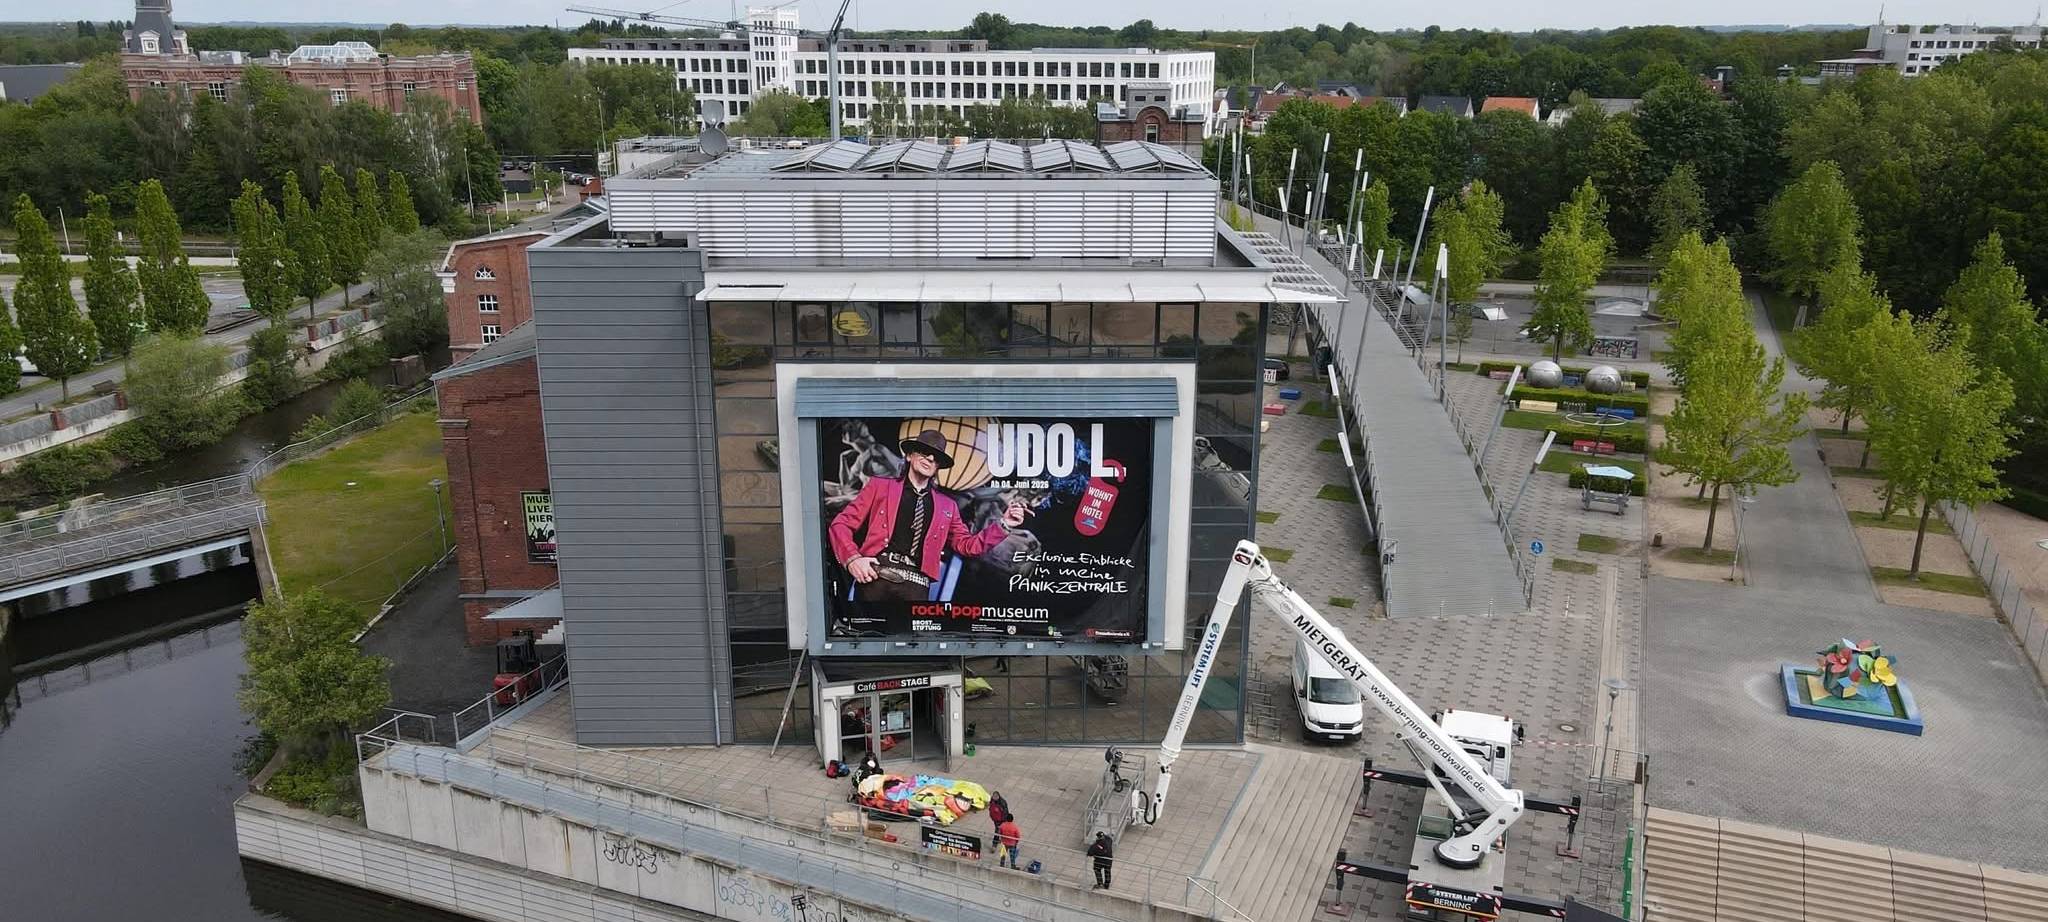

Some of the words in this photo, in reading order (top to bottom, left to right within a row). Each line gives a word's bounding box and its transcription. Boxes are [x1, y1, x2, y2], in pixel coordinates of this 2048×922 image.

[988, 423, 1074, 478] UDO
[990, 480, 1000, 489] Ab
[1014, 480, 1030, 489] Juni
[526, 495, 552, 504] MUSI
[1088, 486, 1114, 503] WOHNT
[1091, 498, 1101, 508] IM
[1081, 505, 1103, 520] HOTEL
[1012, 551, 1078, 563] Exclusive
[1079, 552, 1135, 568] Einblicke
[1034, 563, 1050, 576] in
[1059, 567, 1114, 580] meine
[1009, 574, 1129, 594] PANIK-ZENTRALE
[1198, 632, 1217, 668] SYSTEM
[857, 682, 877, 692] Café
[877, 677, 929, 690] BACKSTAGE
[1191, 669, 1204, 689] LIFT
[1174, 694, 1194, 731] BERNING
[1293, 614, 1368, 682] MIETGERÄT
[1370, 684, 1487, 794] www.berning-nordwalde.de
[1433, 897, 1472, 911] BERNING
[1463, 895, 1479, 903] LIFT
